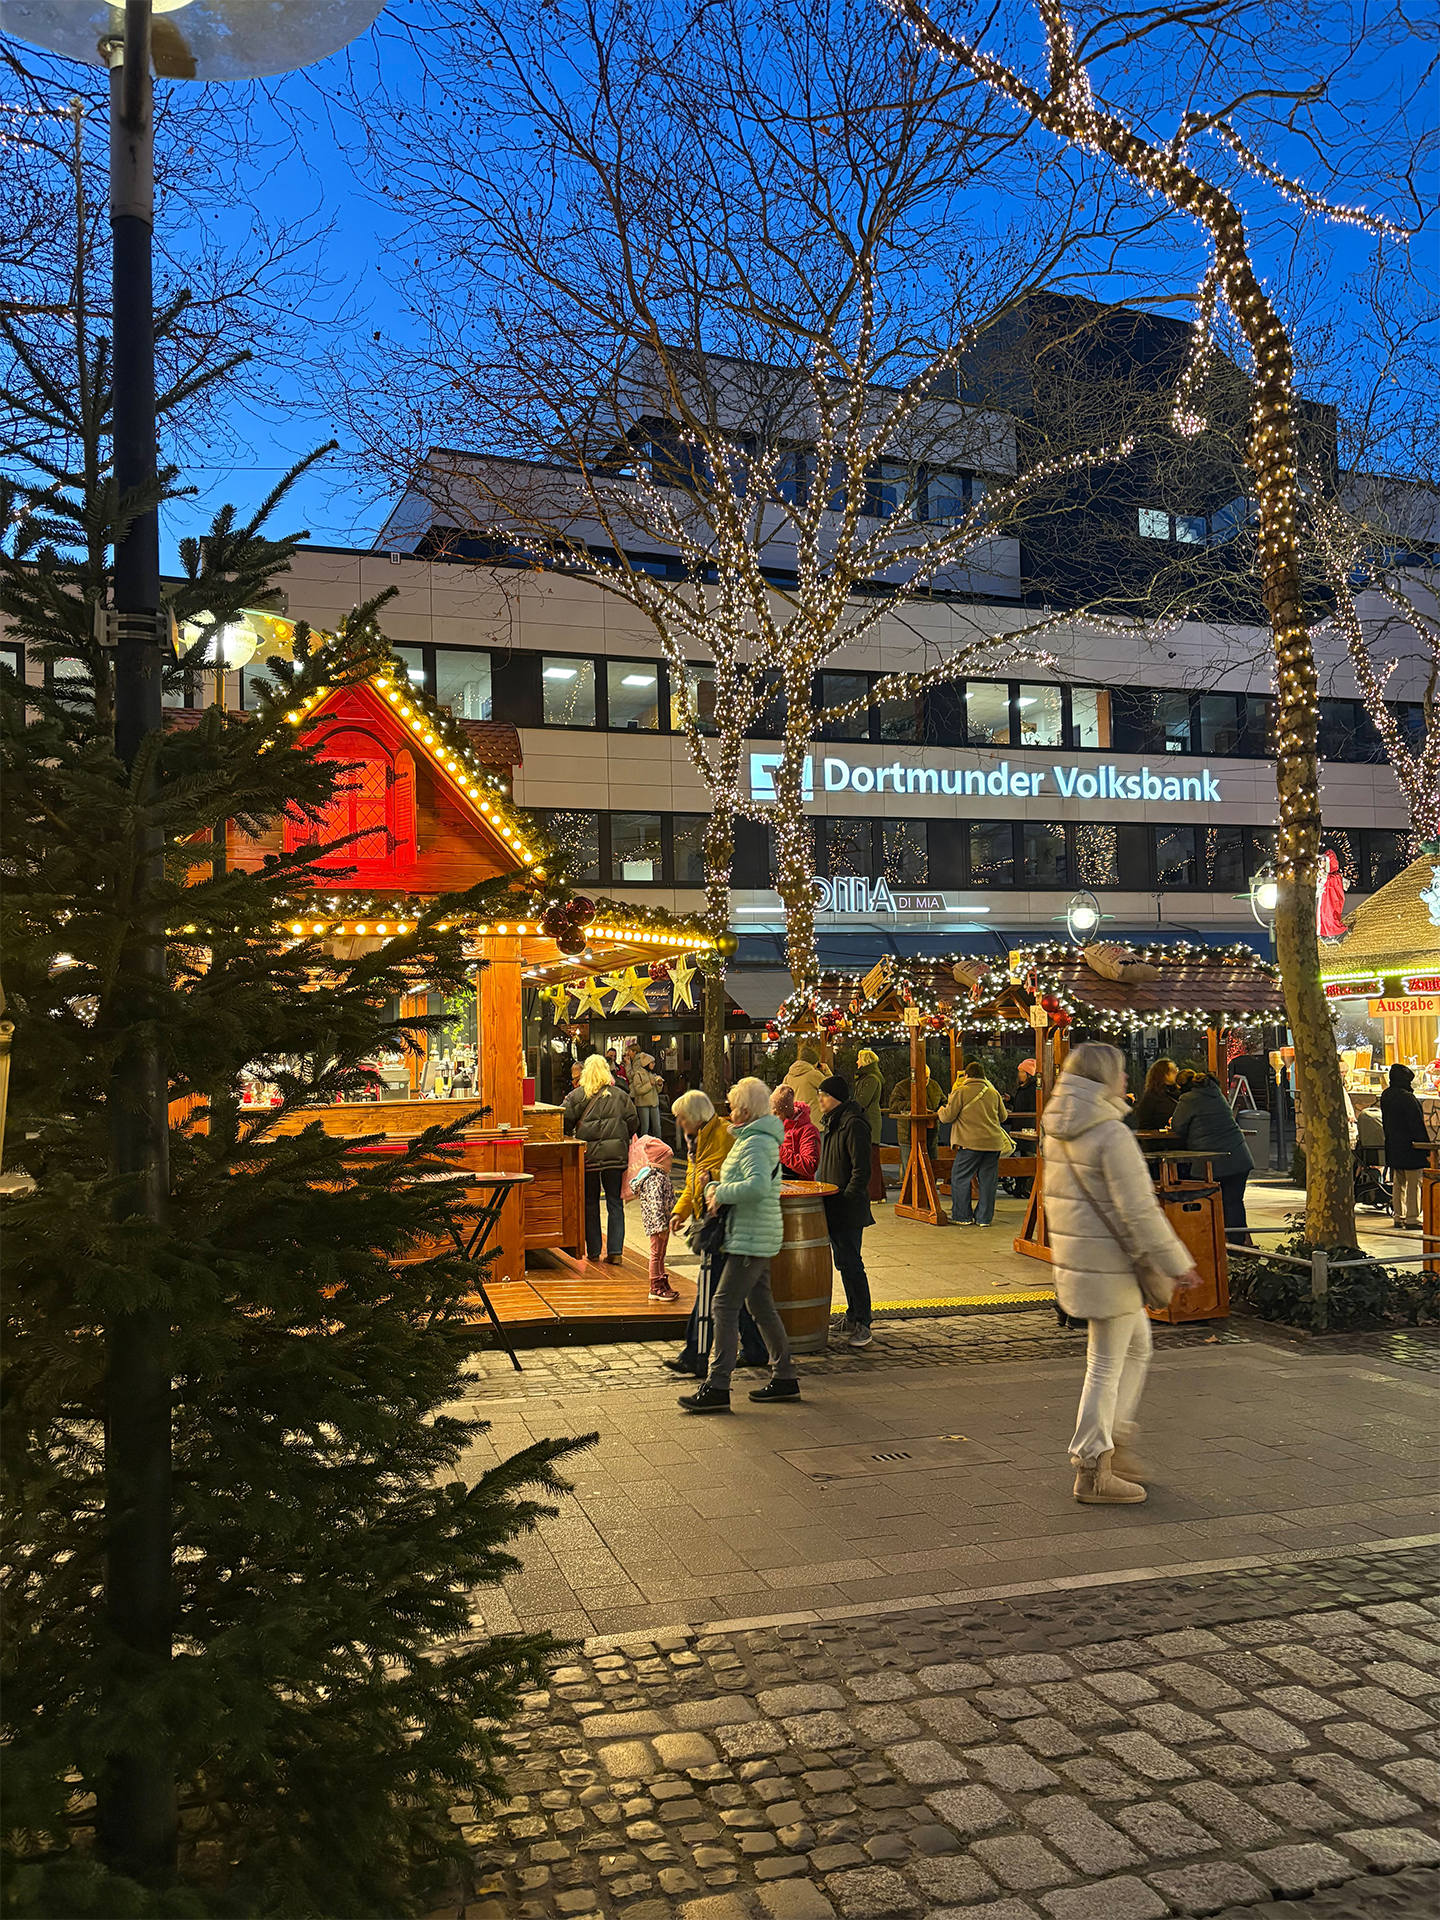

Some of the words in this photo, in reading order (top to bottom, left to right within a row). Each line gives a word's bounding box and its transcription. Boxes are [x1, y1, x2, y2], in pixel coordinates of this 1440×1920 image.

[823, 757, 1045, 797] Dortmunder
[1053, 765, 1222, 802] Volksbank
[898, 896, 911, 909] DI
[915, 896, 940, 909] MIA
[1375, 996, 1434, 1015] Ausgabe
